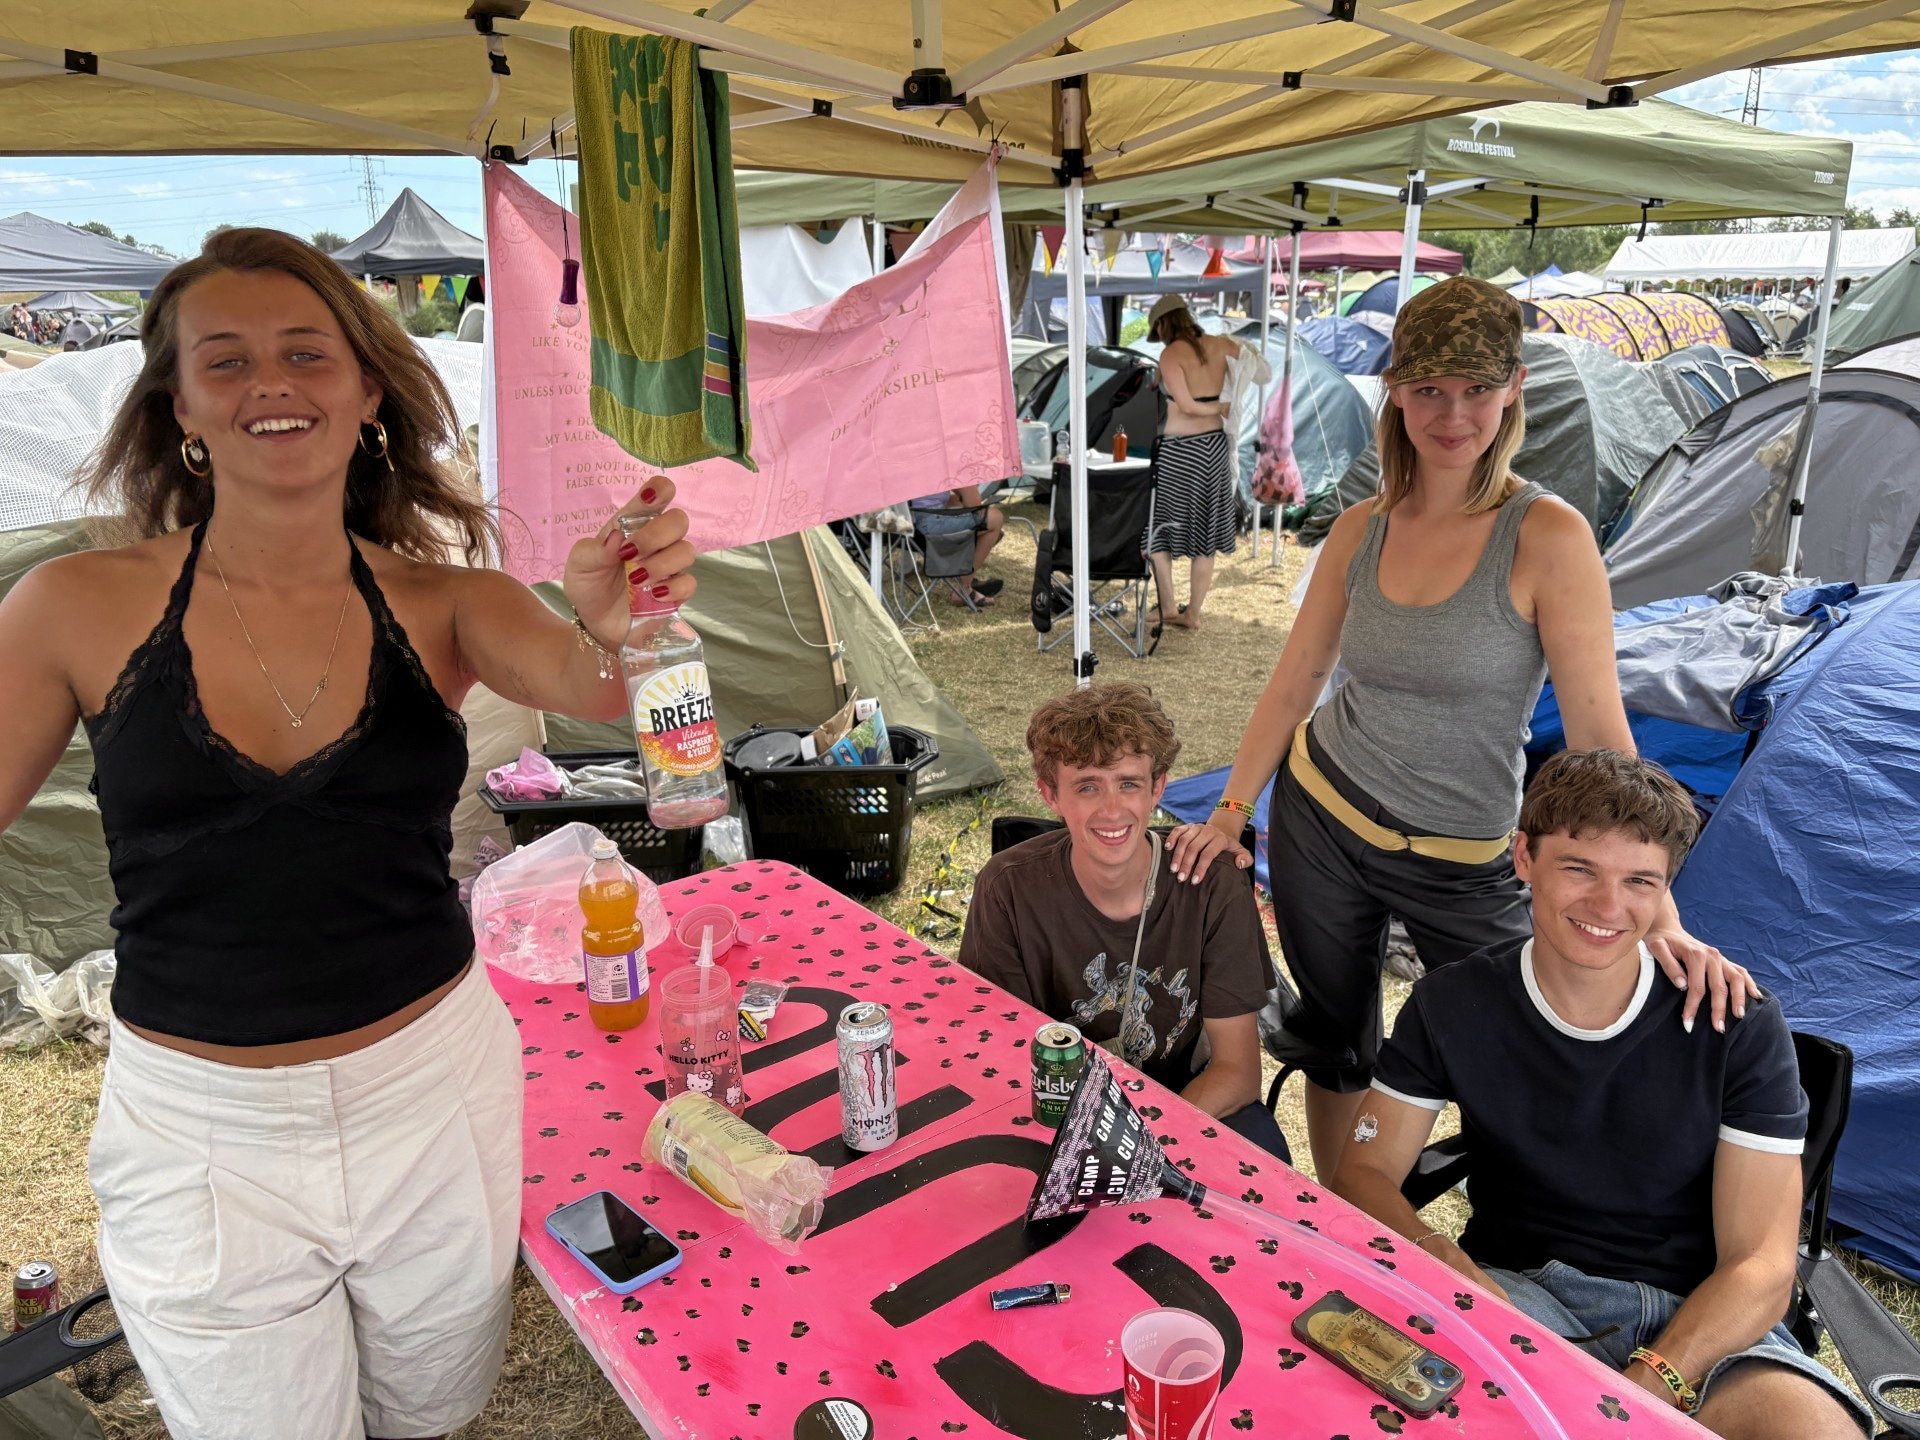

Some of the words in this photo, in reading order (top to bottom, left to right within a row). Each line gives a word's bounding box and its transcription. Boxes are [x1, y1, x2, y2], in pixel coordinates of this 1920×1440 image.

[1447, 139, 1484, 154] ROSKILDE
[1485, 143, 1516, 158] FESTIVAL
[532, 336, 560, 348] LIKE
[514, 386, 554, 400] UNLESS
[545, 434, 560, 447] MY
[576, 463, 591, 473] DO
[595, 461, 620, 473] NOT
[566, 476, 594, 490] FALSE
[554, 514, 567, 524] DO
[571, 510, 590, 522] NOT
[681, 725, 709, 742] Vibrant
[677, 734, 714, 751] RASPBERRY
[669, 1054, 698, 1065] HELLO
[701, 1049, 729, 1065] KITTY
[1096, 1101, 1116, 1142] CAM
[876, 1129, 896, 1141] ULTRA
[1117, 1129, 1136, 1161] CU
[1078, 1155, 1100, 1196] CAMP
[1655, 1361, 1683, 1392] RF26
